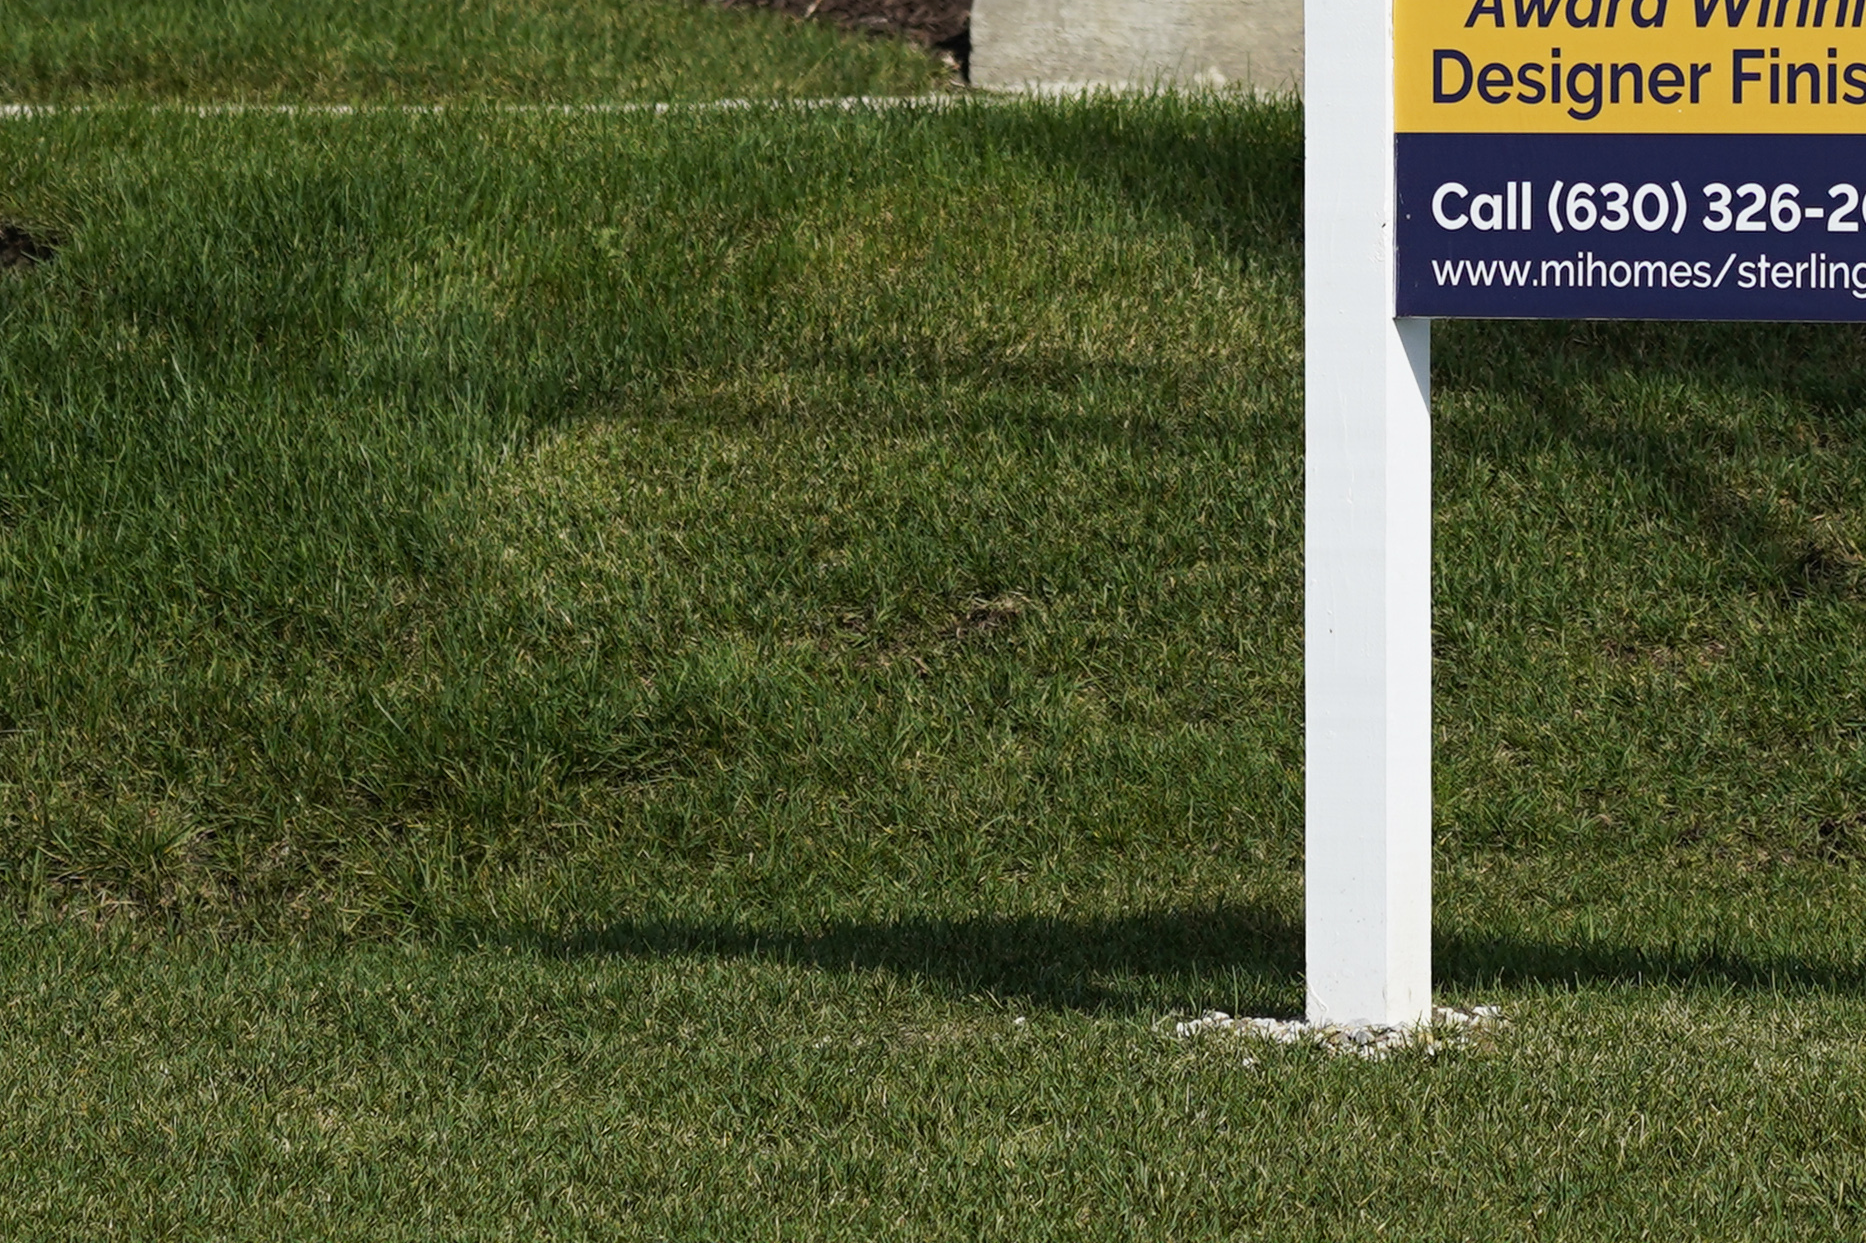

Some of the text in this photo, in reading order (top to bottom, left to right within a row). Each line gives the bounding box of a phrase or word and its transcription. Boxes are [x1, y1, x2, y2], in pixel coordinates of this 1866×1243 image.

[1432, 47, 1712, 121] Designer
[1431, 181, 1532, 231] Call
[1548, 180, 1687, 234] (630)
